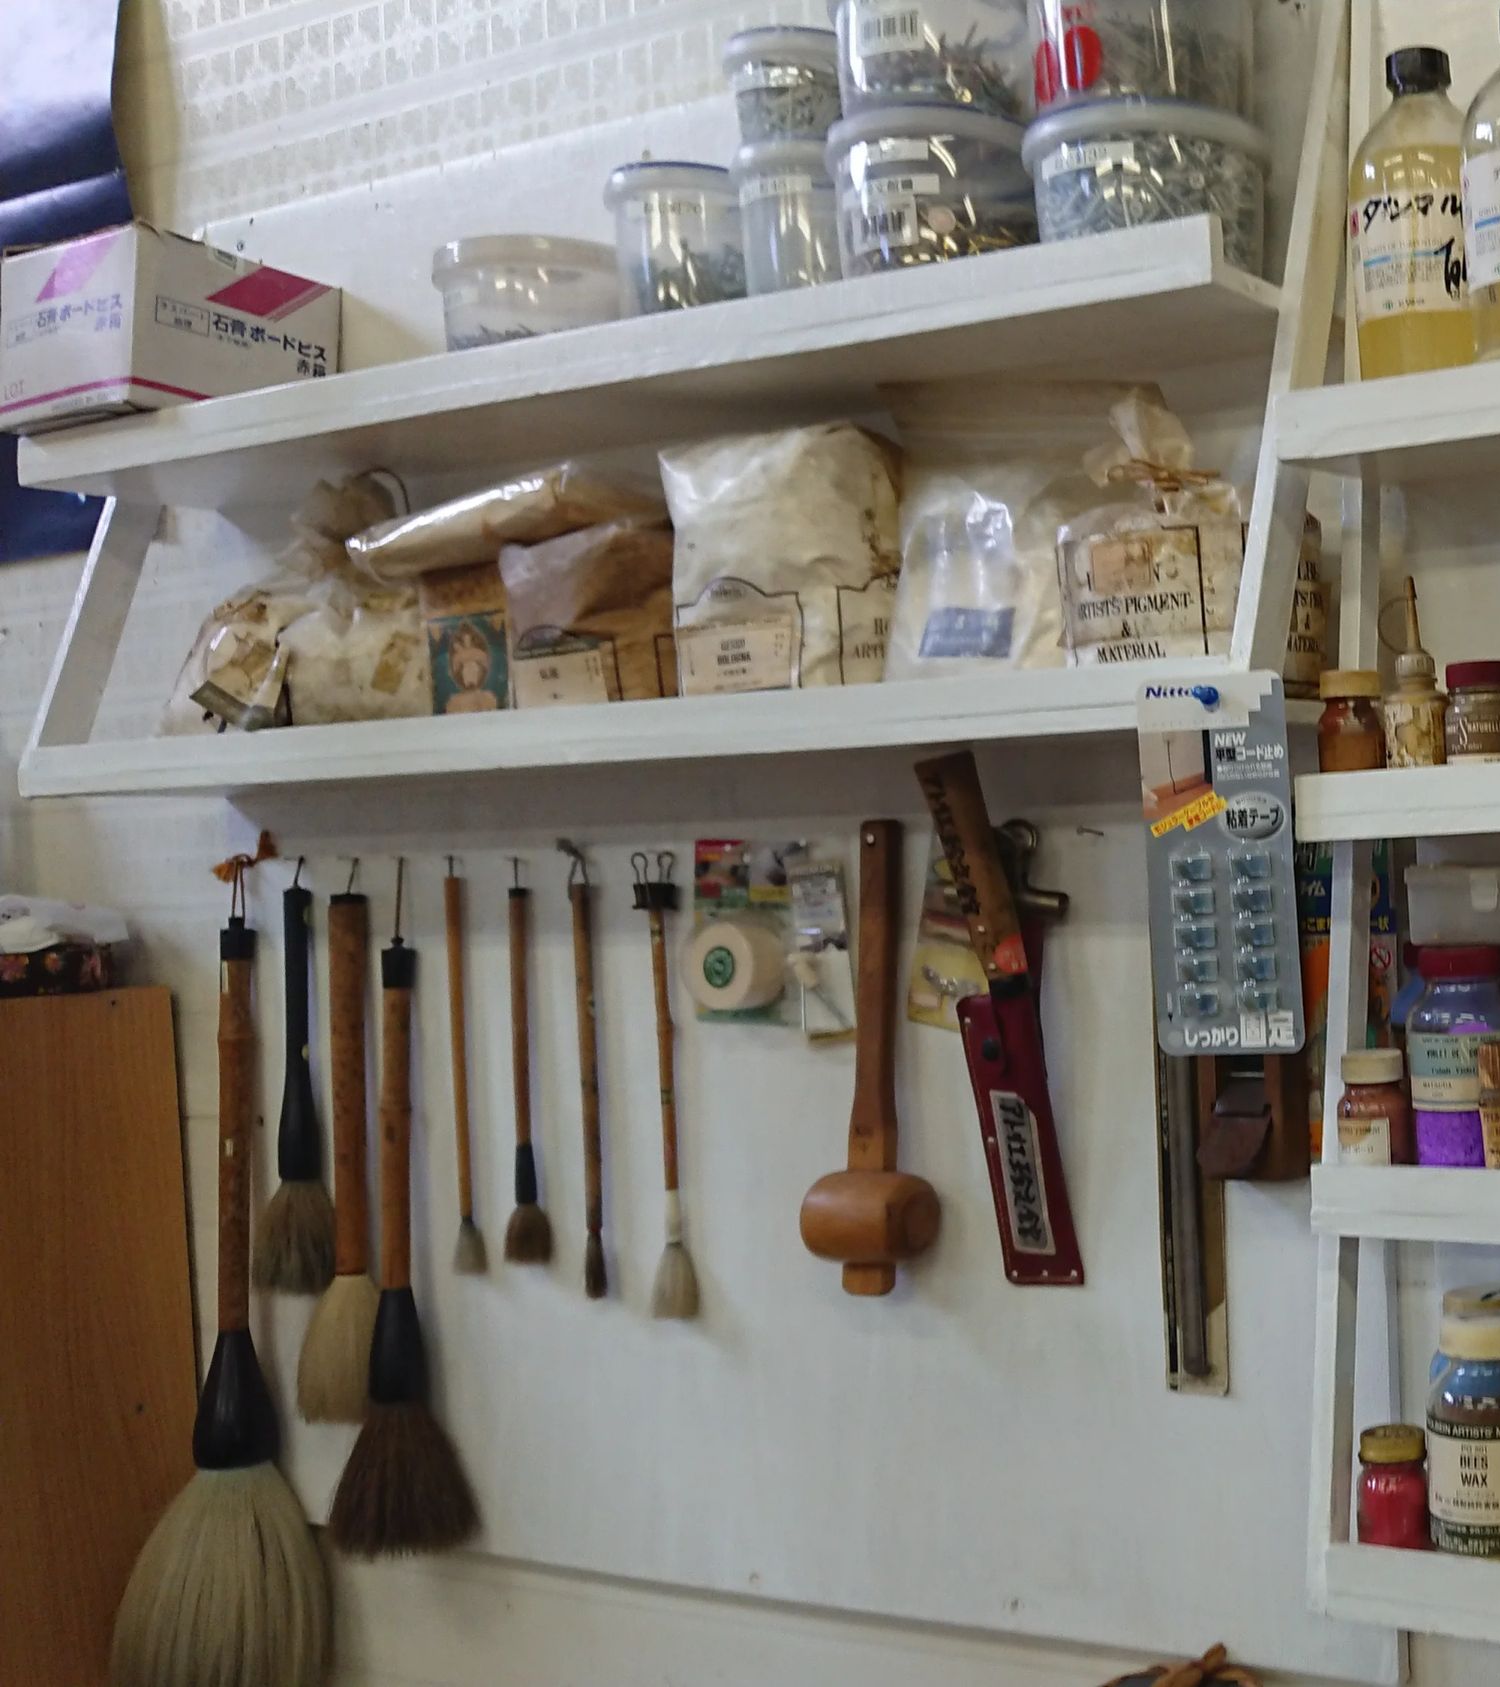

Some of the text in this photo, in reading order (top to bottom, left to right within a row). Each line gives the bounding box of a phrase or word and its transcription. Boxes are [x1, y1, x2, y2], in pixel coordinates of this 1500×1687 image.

[211, 312, 327, 362] 石膏ボードビス
[1124, 592, 1196, 615] PIGMENT
[1121, 619, 1131, 638] &
[1097, 640, 1167, 664] MATERIAL
[1214, 732, 1247, 747] NEW
[1225, 804, 1281, 830] 粘着テープ
[1184, 1010, 1296, 1048] しっかり固定
[1460, 1473, 1488, 1488] WAX
